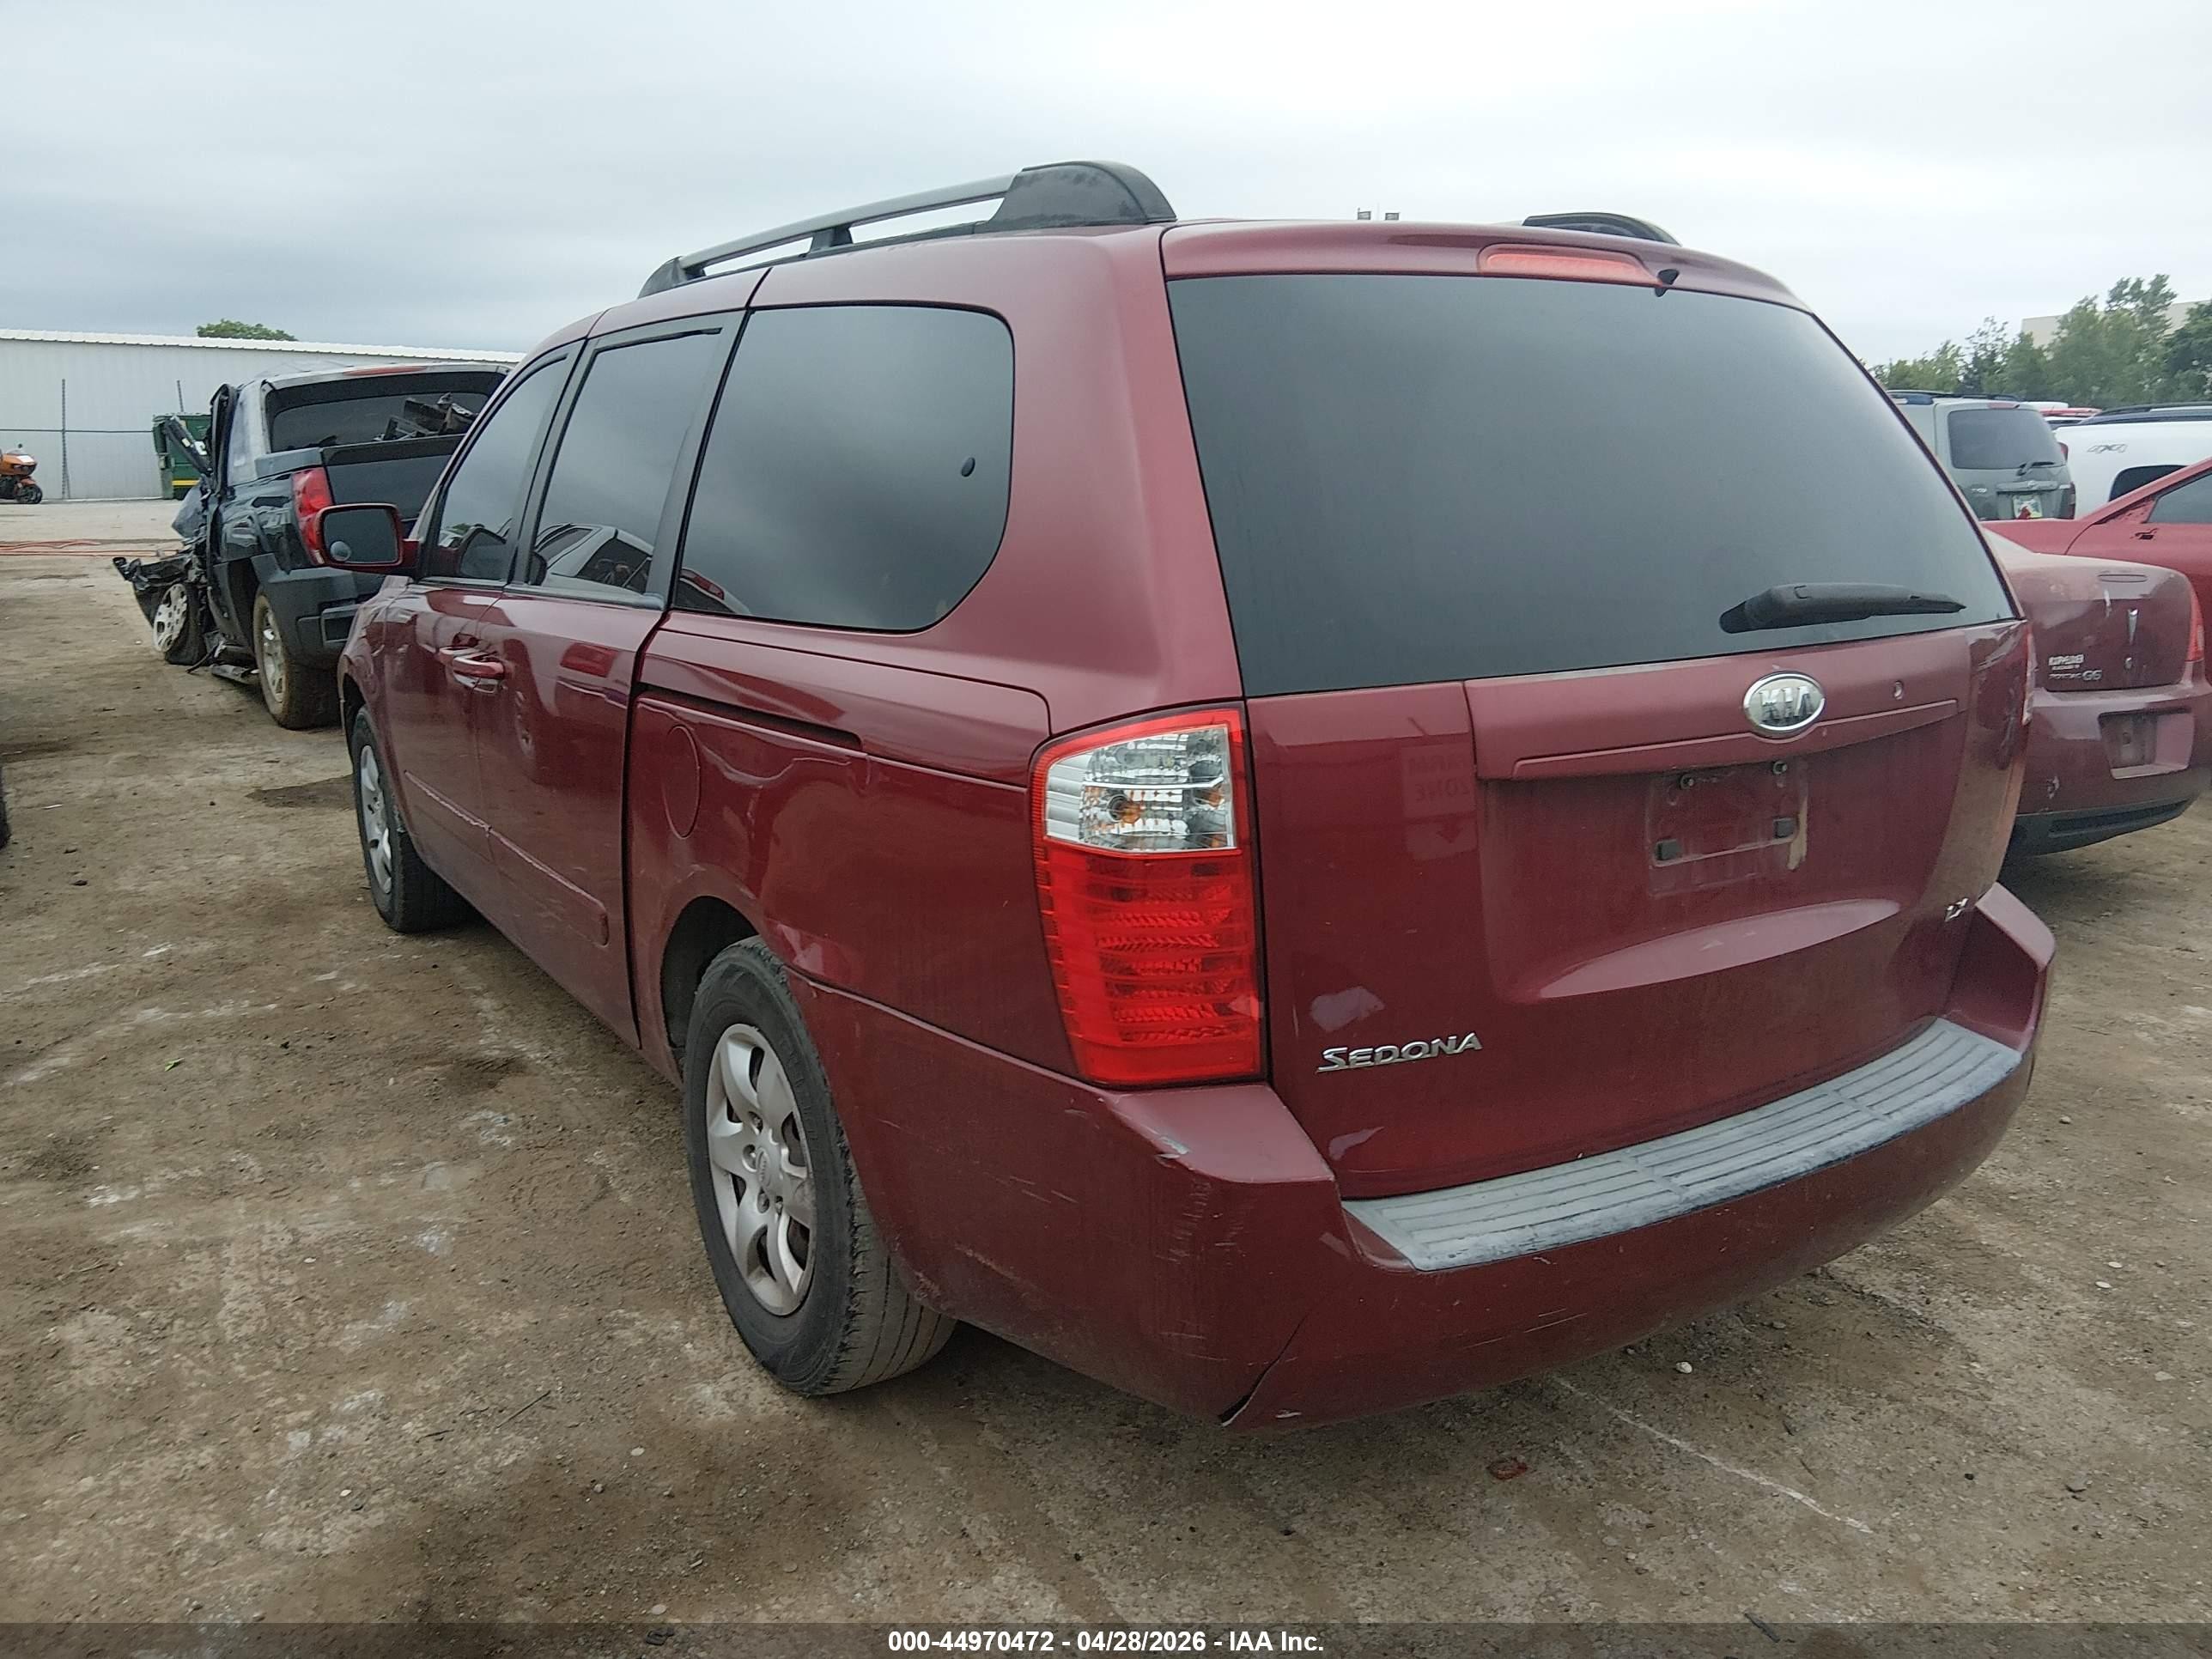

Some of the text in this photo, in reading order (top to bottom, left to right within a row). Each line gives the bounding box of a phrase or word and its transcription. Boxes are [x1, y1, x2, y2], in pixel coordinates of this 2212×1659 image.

[2081, 670, 2103, 681] G6
[1758, 686, 1814, 723] KIA
[1316, 1032, 1484, 1073] SEDONA
